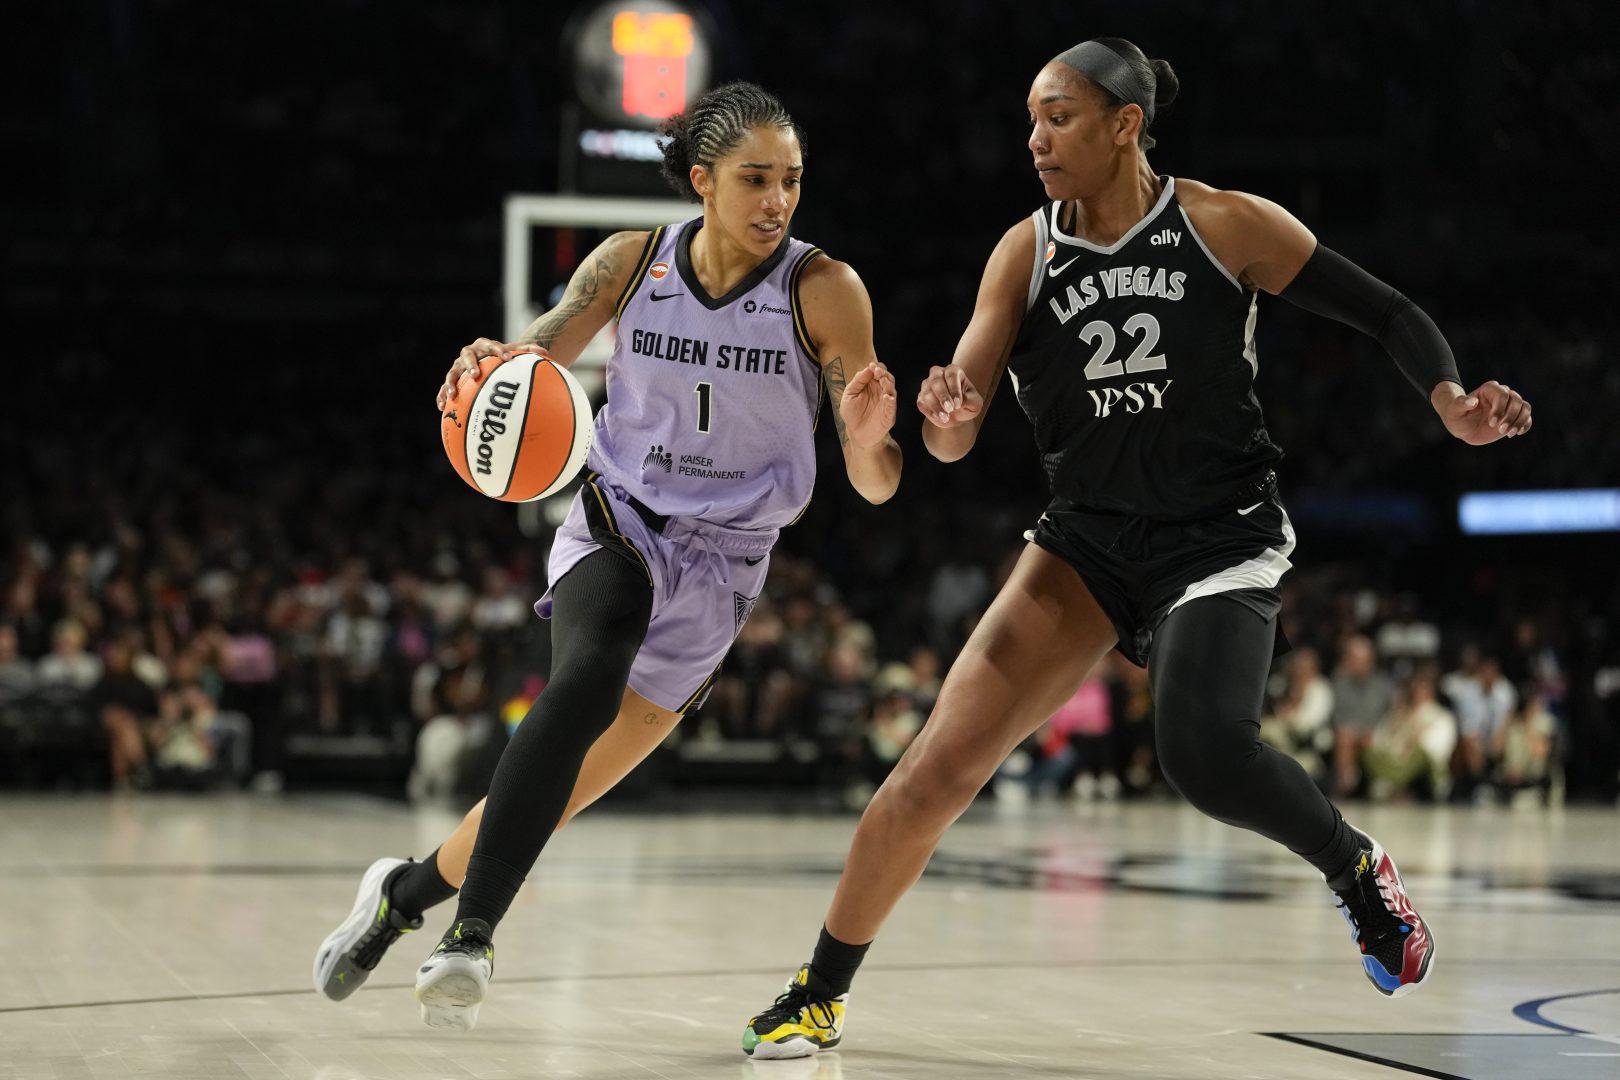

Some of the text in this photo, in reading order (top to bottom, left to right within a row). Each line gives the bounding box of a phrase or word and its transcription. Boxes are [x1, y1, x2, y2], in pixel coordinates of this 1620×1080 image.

[1150, 229, 1181, 247] ally
[759, 303, 791, 316] freedom
[1048, 265, 1187, 325] LAS VEGAS
[632, 329, 787, 375] GOLDEN STATE
[1078, 312, 1167, 381] 22
[693, 381, 713, 434] 1
[1086, 379, 1173, 418] IPSY
[476, 380, 521, 476] Wilson
[678, 466, 746, 480] PERMANENTE
[680, 454, 714, 468] KAISER
